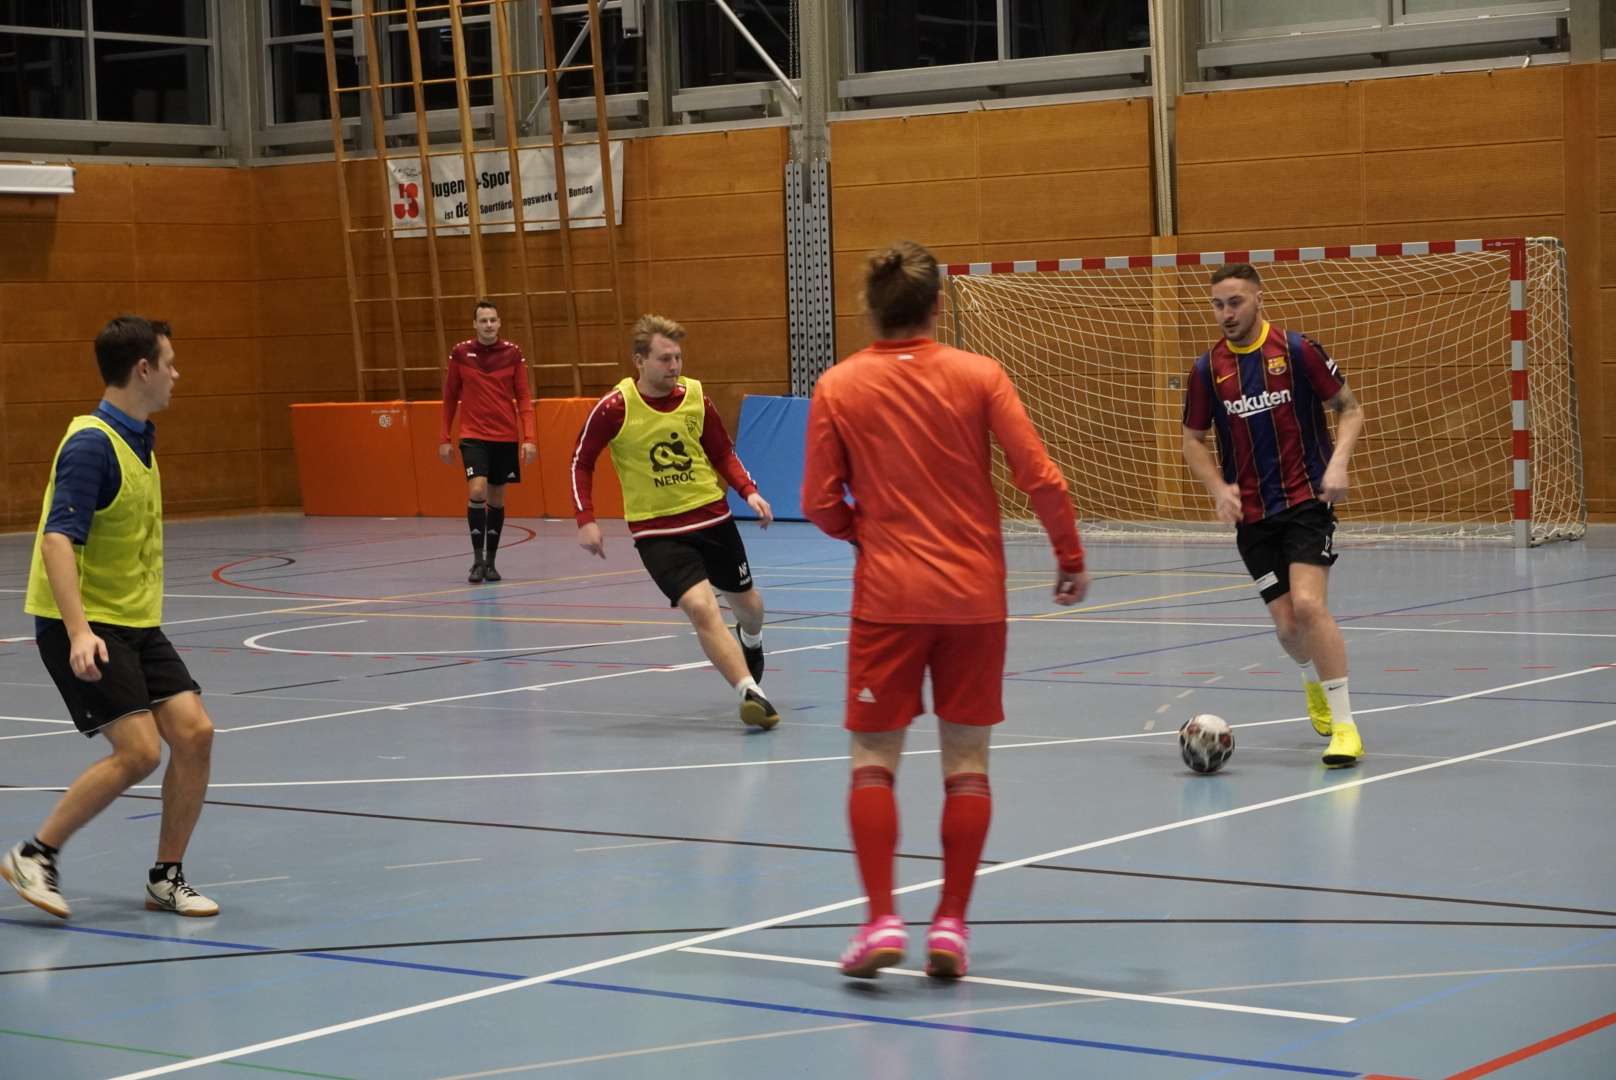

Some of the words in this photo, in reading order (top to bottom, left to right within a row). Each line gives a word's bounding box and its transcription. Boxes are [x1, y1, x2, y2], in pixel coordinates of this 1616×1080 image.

[444, 211, 454, 220] ist
[456, 201, 469, 218] da
[568, 185, 593, 198] Bundes
[1223, 389, 1292, 416] Rakuten
[653, 470, 696, 488] NEROC
